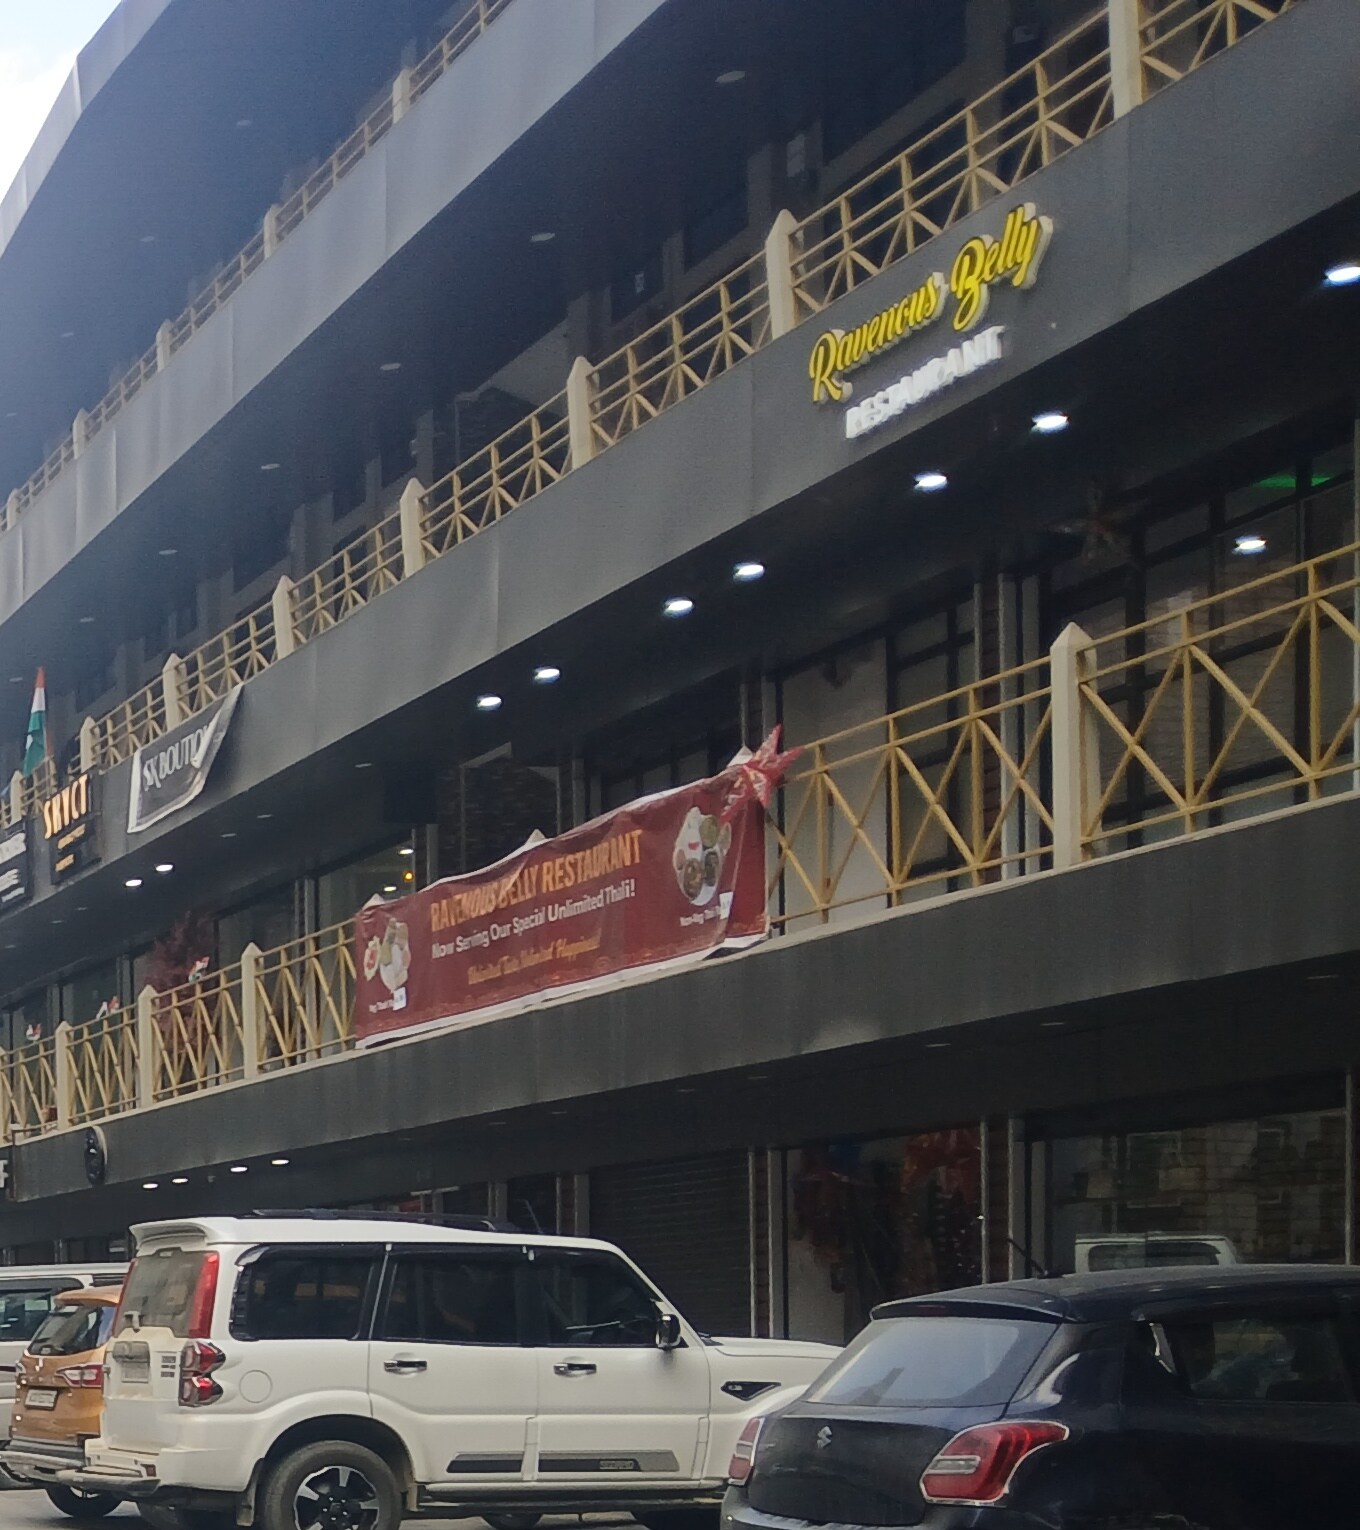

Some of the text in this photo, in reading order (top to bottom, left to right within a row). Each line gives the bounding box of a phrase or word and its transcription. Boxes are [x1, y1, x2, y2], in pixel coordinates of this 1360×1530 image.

[951, 202, 1053, 332] Belly
[542, 829, 642, 893] RESTAURANT
[431, 942, 456, 960] Now
[456, 930, 489, 952] Serving
[490, 923, 512, 941] Our
[513, 906, 546, 936] Special
[548, 888, 605, 922] Unlimited
